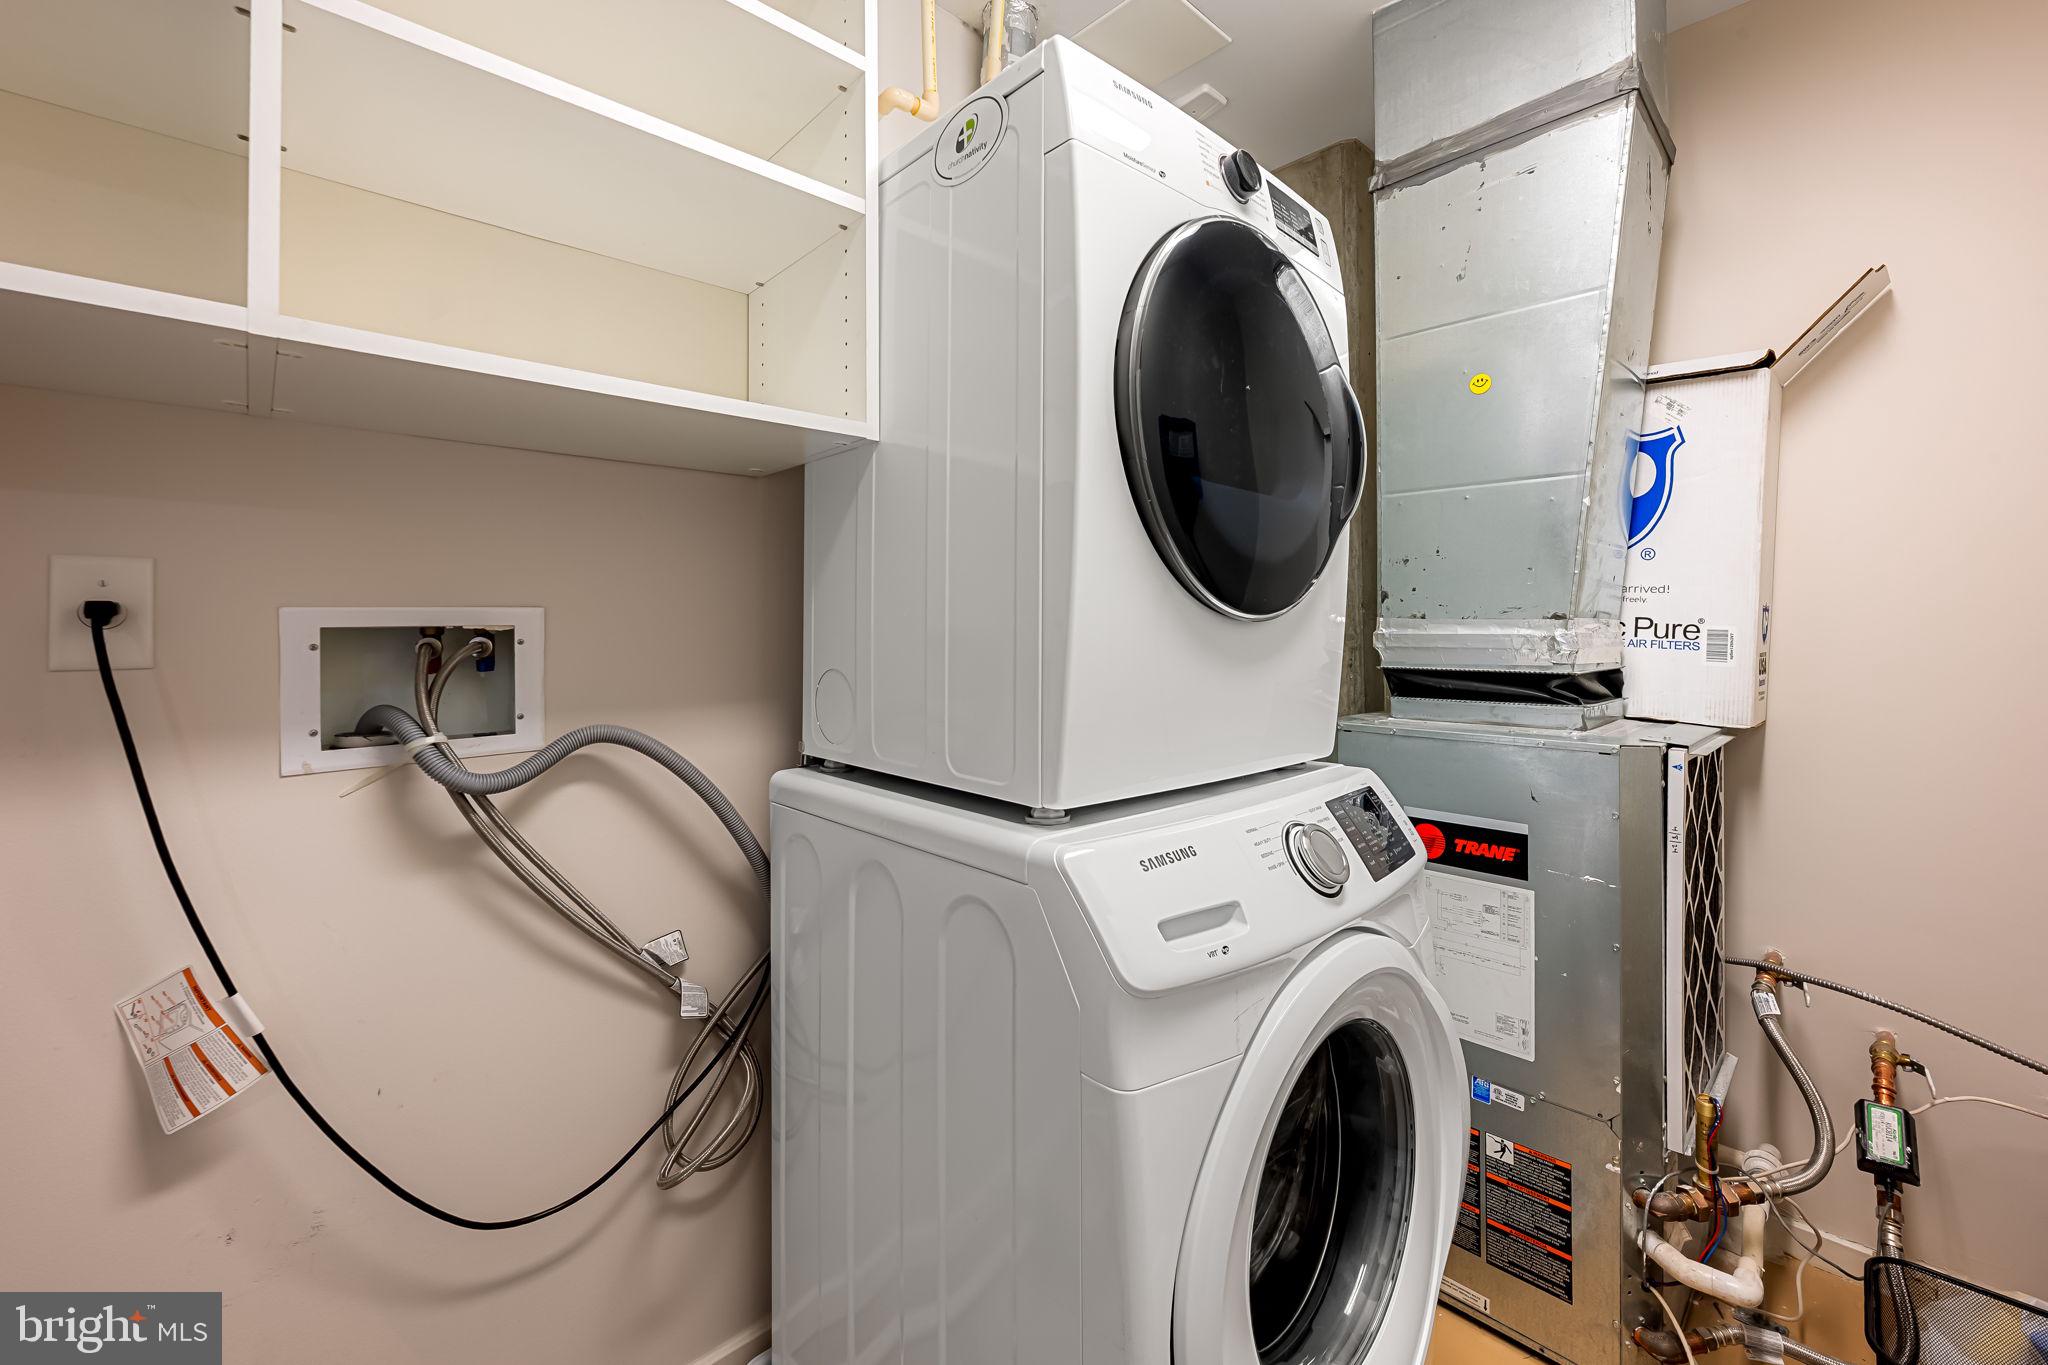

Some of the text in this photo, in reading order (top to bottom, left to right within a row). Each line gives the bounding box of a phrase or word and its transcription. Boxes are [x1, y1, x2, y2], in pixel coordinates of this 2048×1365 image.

[1112, 80, 1153, 108] SAMSUNG
[1622, 584, 1670, 594] arrived!
[1627, 638, 1701, 651] AIR FILTERS
[1139, 845, 1197, 872] SAMSUNG
[1455, 838, 1517, 862] TRANE
